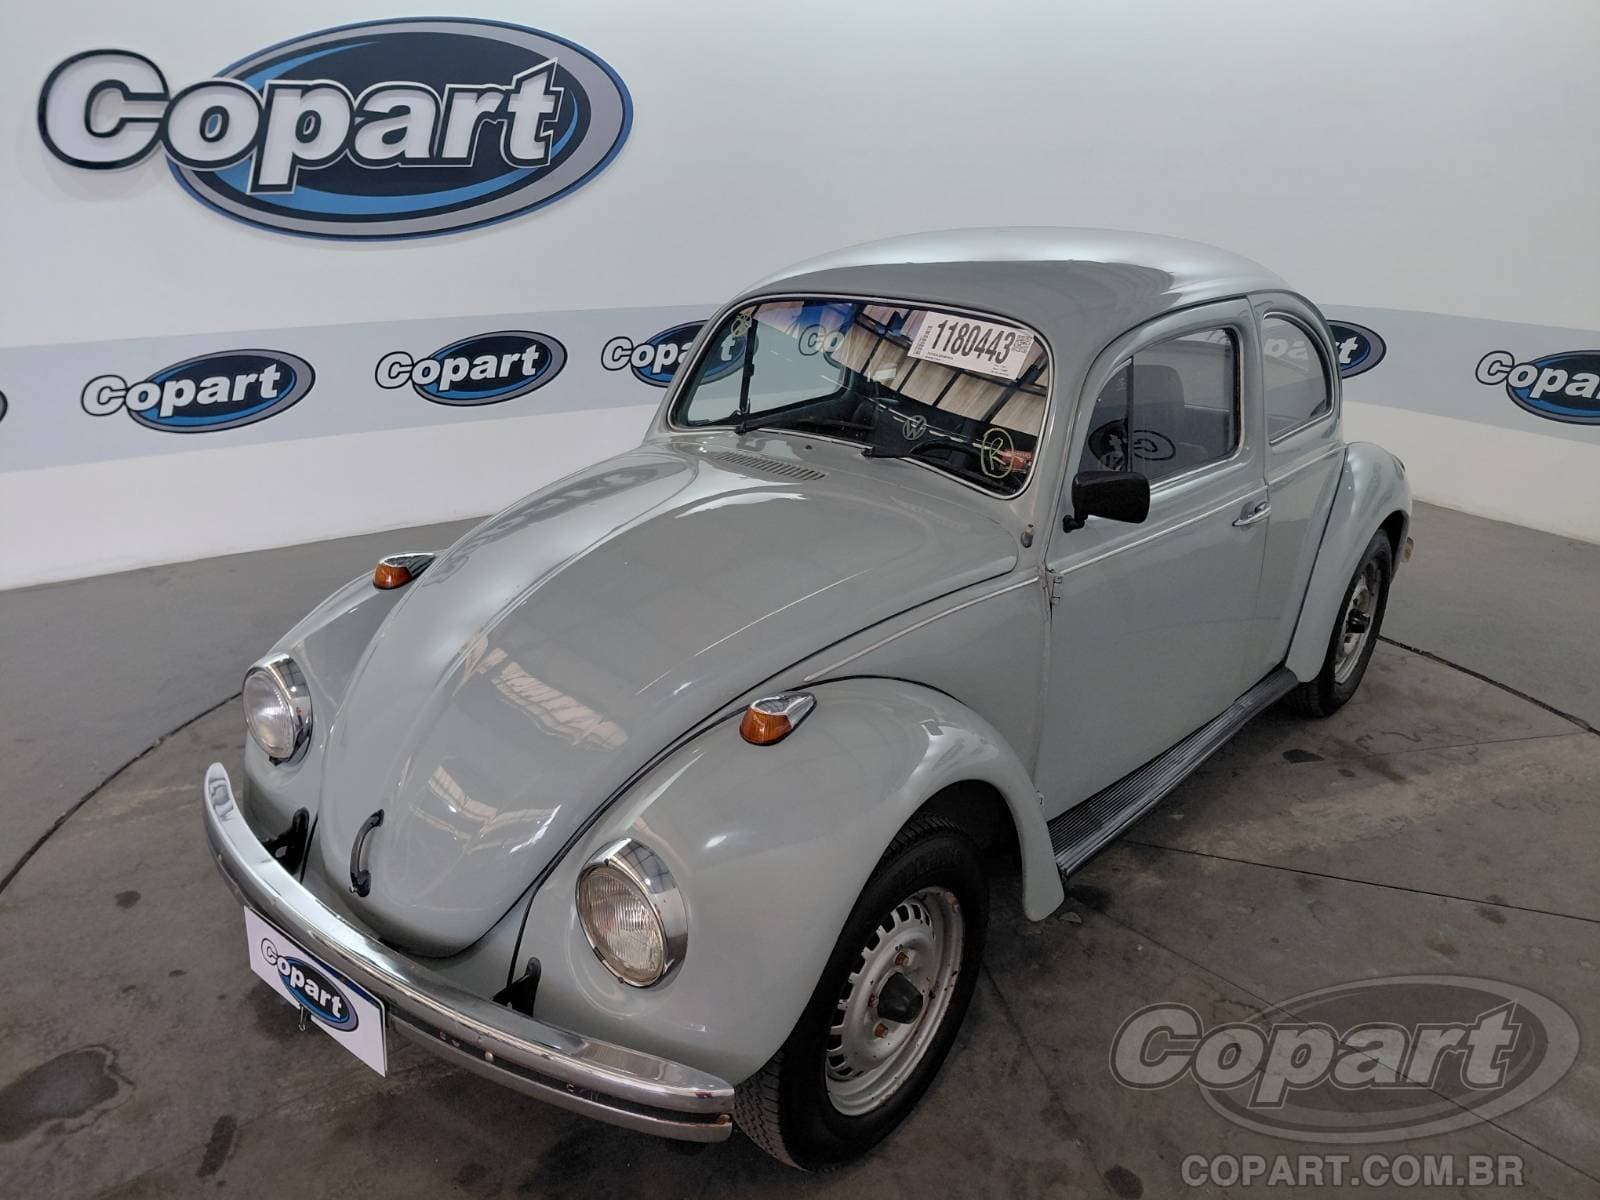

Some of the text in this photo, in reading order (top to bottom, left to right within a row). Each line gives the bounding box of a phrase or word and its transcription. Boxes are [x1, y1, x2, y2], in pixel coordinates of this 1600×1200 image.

[39, 48, 565, 194] Copart
[931, 319, 1015, 364] 1180443
[81, 364, 281, 417] Copart
[375, 344, 541, 391] Copart
[1475, 350, 1600, 400] Copa
[261, 937, 342, 1018] Copart
